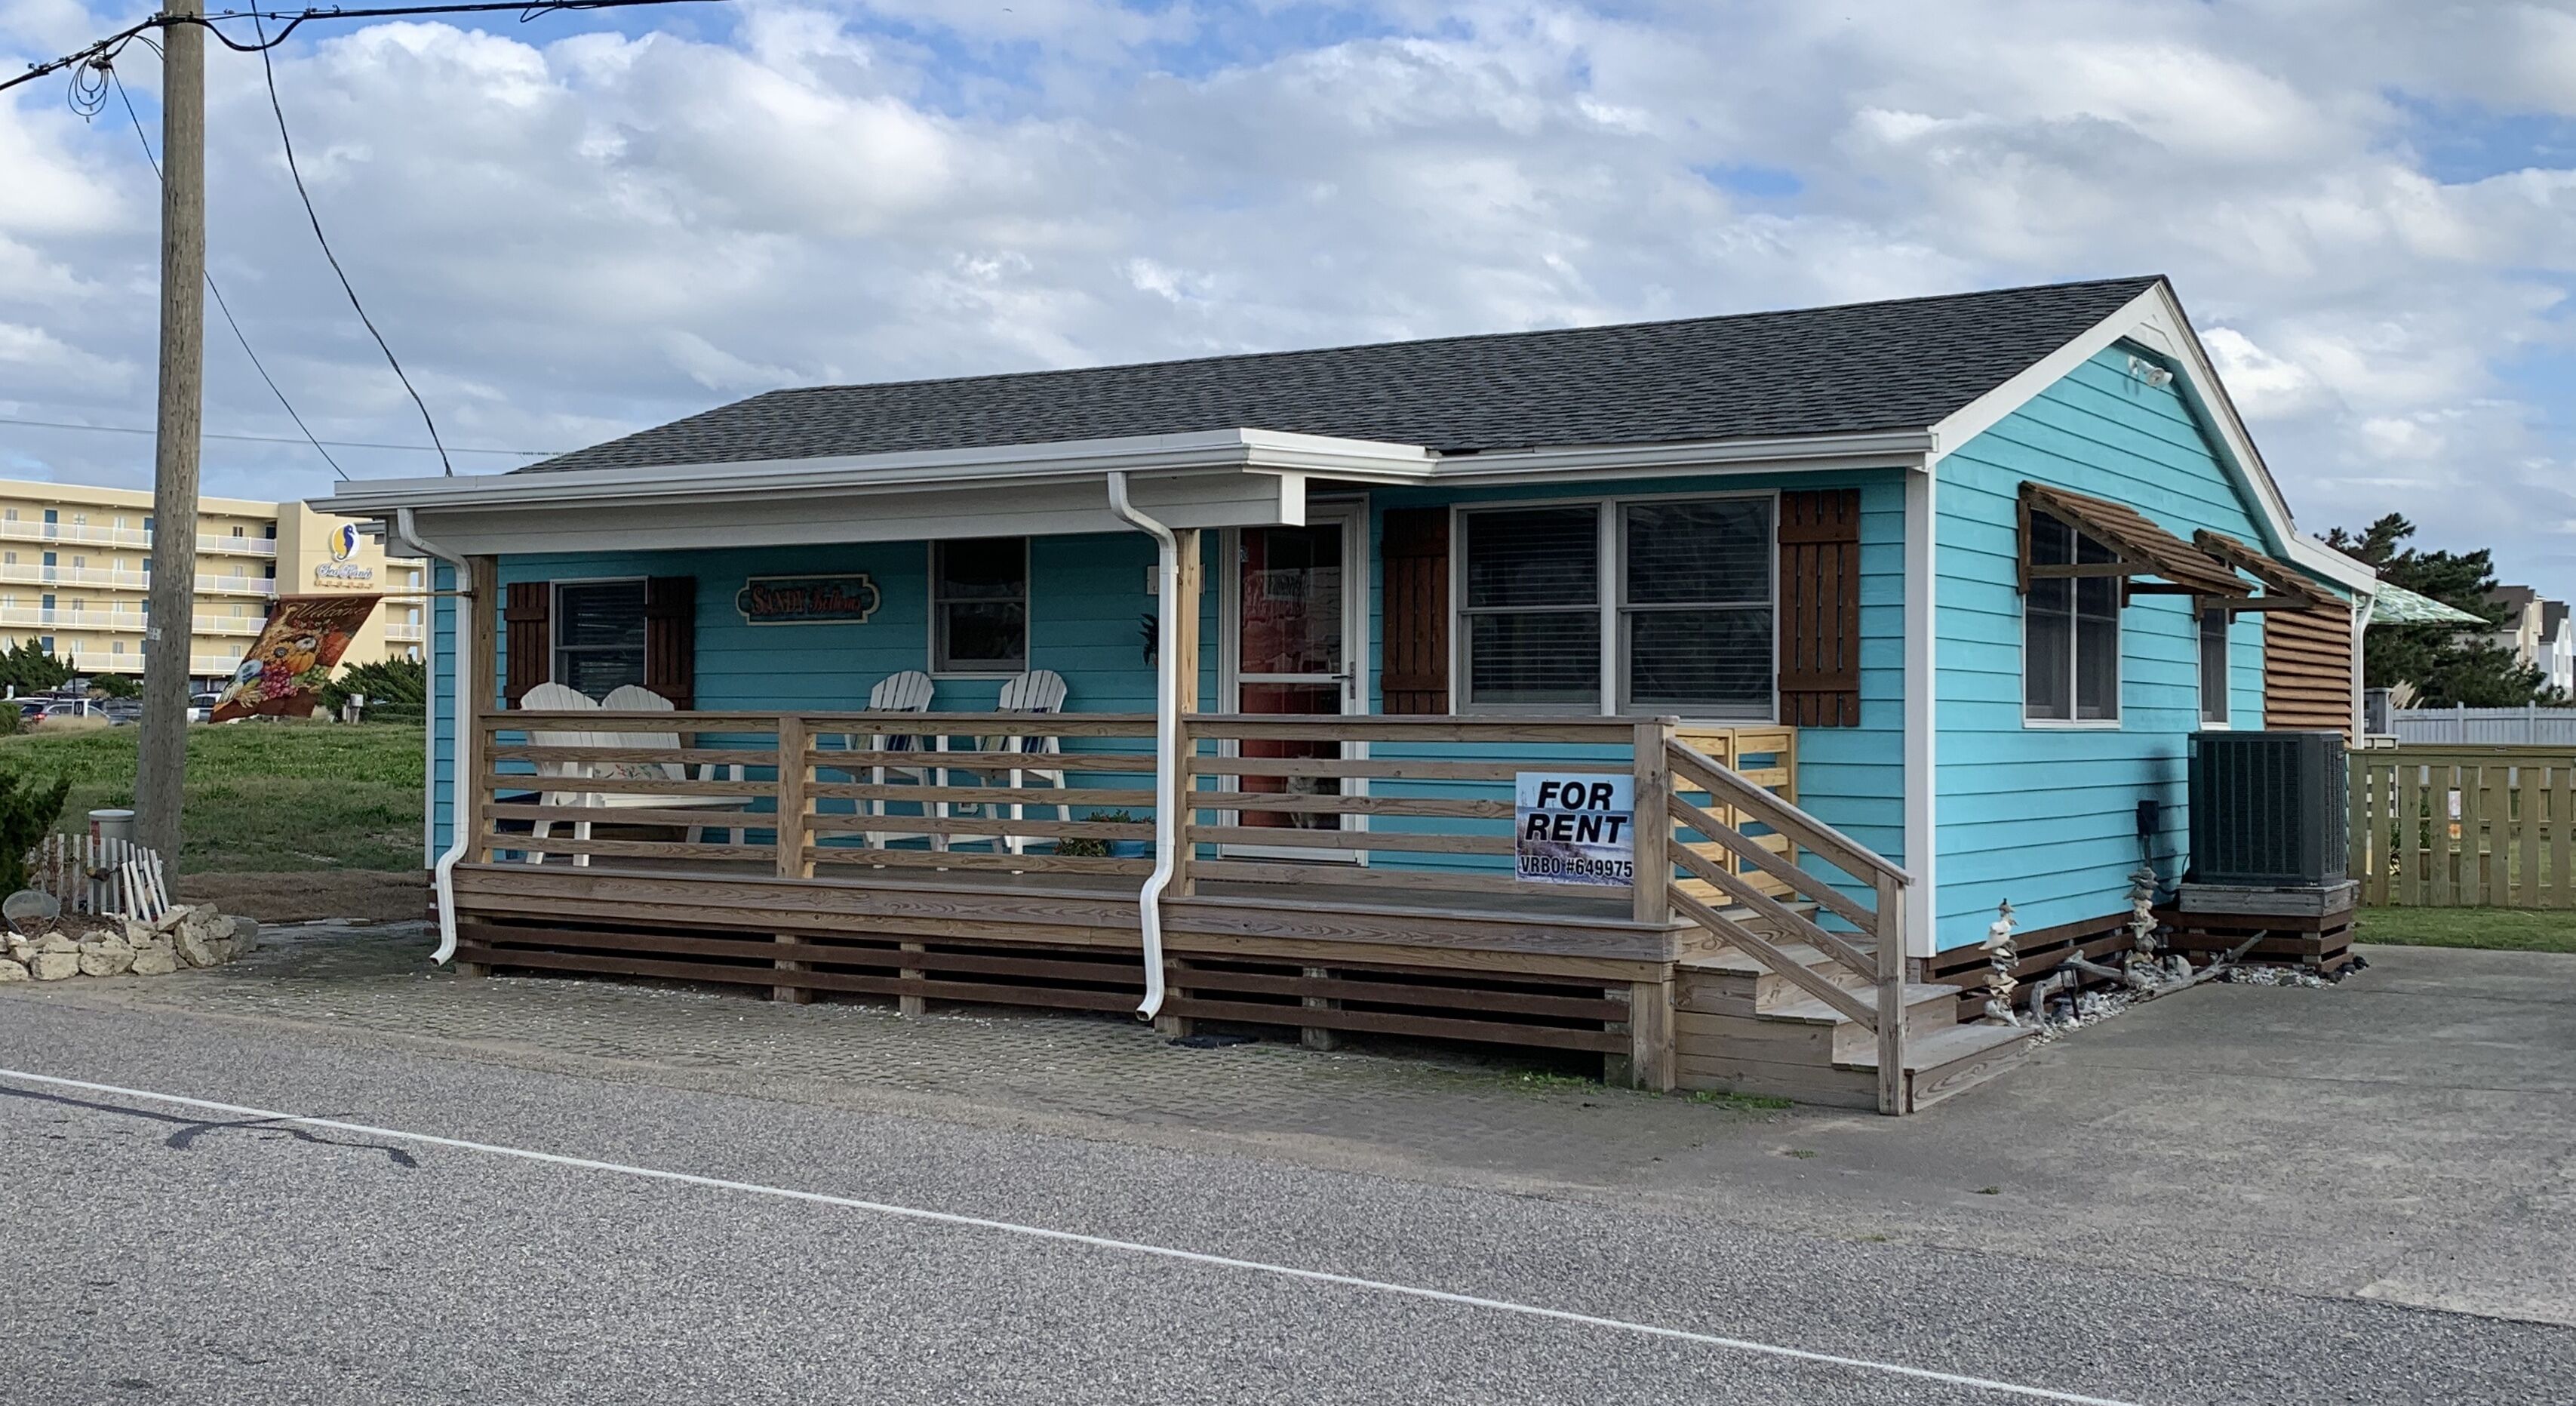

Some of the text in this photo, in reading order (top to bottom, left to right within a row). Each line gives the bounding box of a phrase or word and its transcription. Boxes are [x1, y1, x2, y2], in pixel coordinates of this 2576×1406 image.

[287, 598, 370, 619] Welcome
[1536, 780, 1614, 811] FOR
[1525, 813, 1628, 844] RENT
[1520, 856, 1634, 878] VRBO #649975
